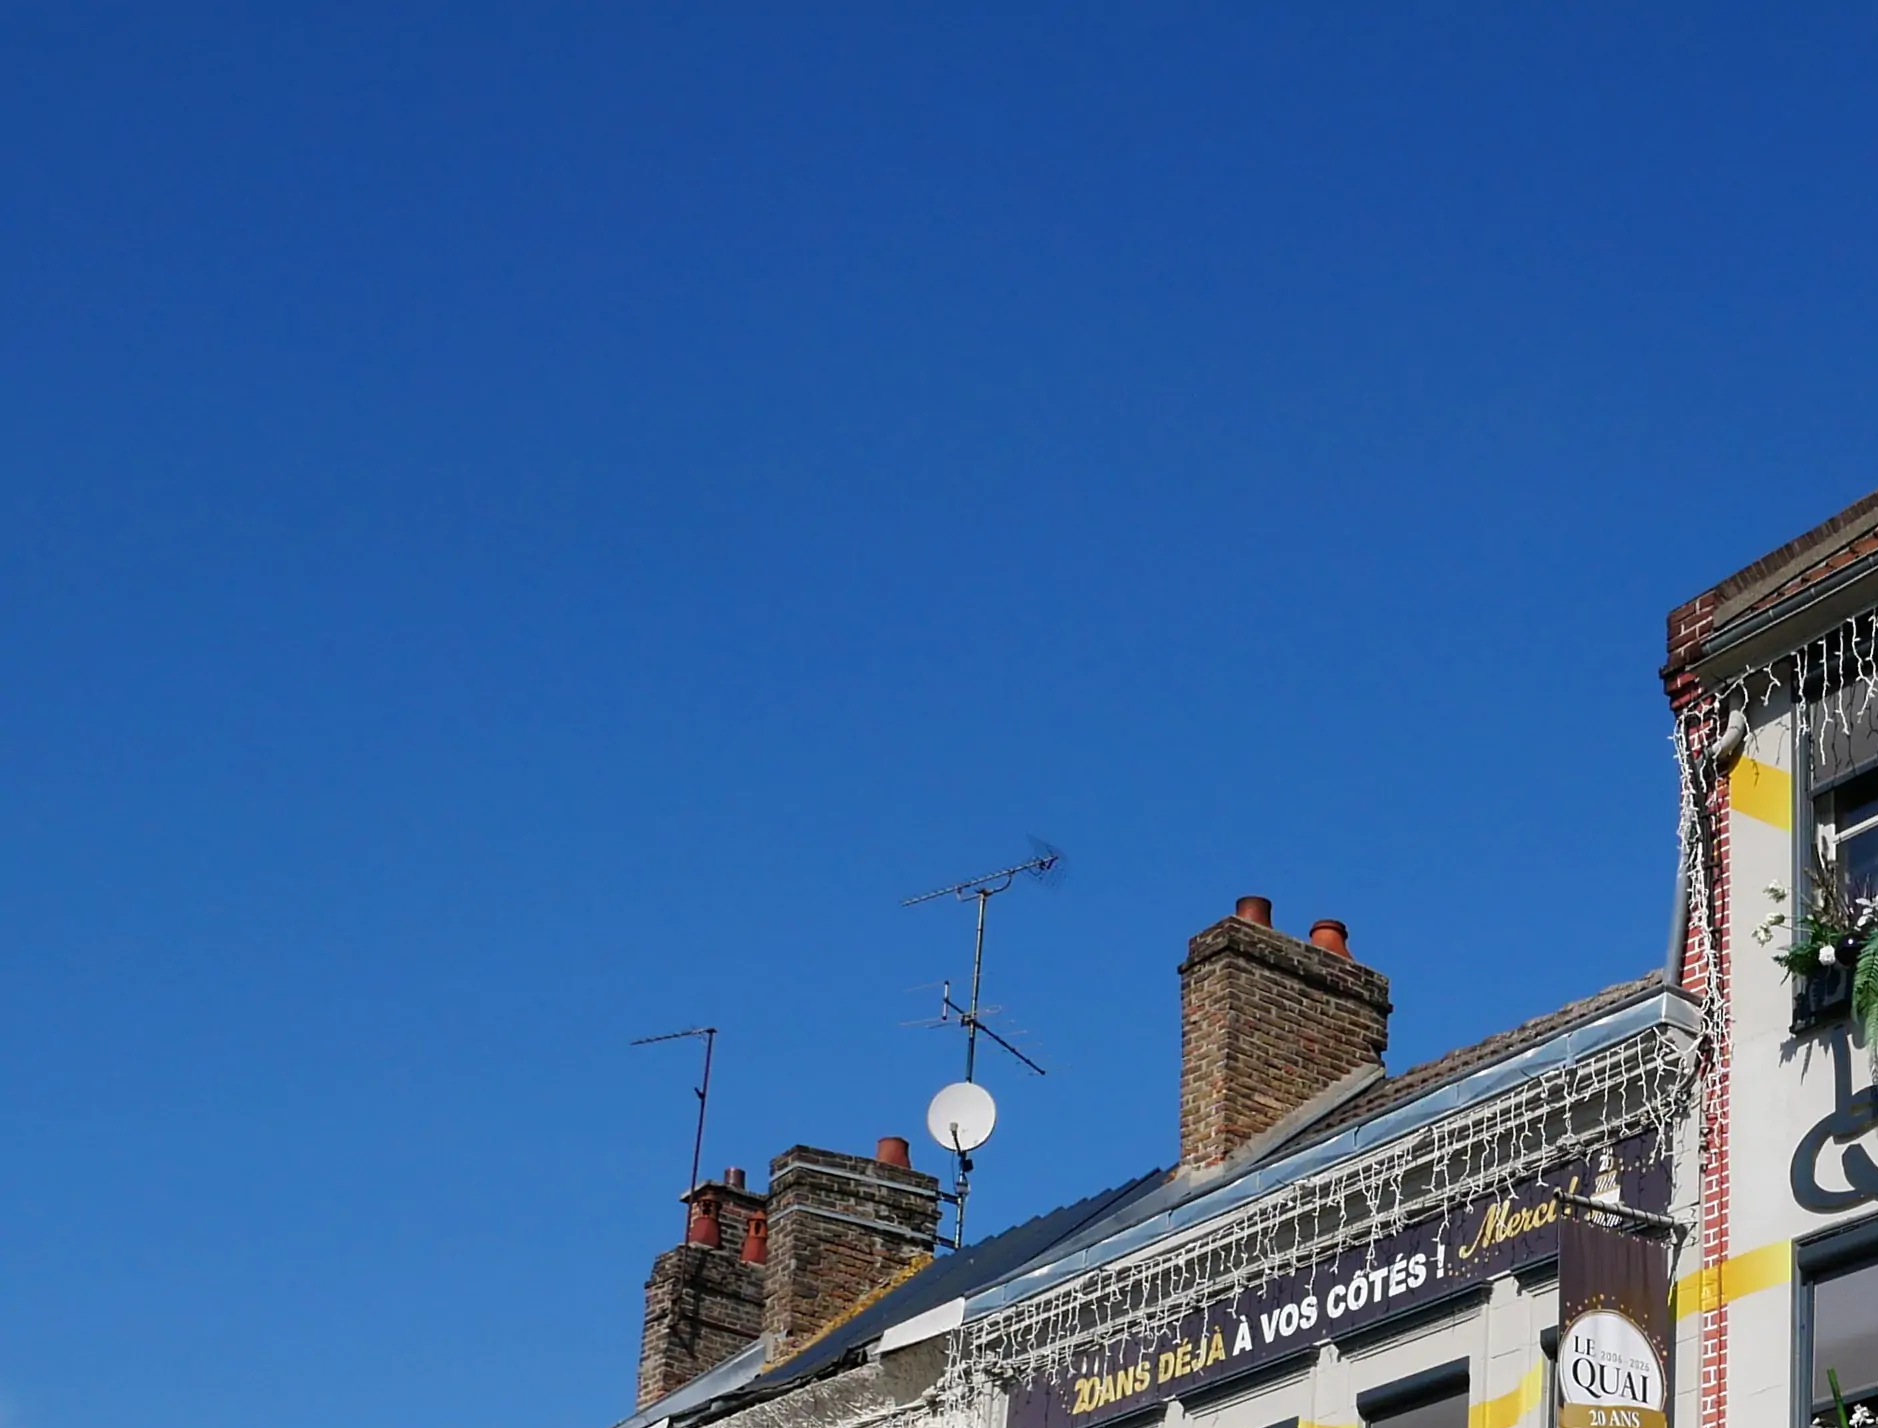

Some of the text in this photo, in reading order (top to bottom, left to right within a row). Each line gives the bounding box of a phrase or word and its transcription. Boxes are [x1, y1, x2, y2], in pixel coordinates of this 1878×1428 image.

[1158, 1325, 1226, 1384] DÉJÀ
[1232, 1315, 1253, 1357] À
[1259, 1302, 1319, 1344] VOS
[1326, 1256, 1428, 1320] CÔTÉS
[1573, 1335, 1597, 1359] LE
[1600, 1350, 1623, 1365] 2006
[1629, 1357, 1650, 1372] 2026
[1572, 1357, 1650, 1404] QUAI
[1588, 1409, 1640, 1428] 20 ANS
